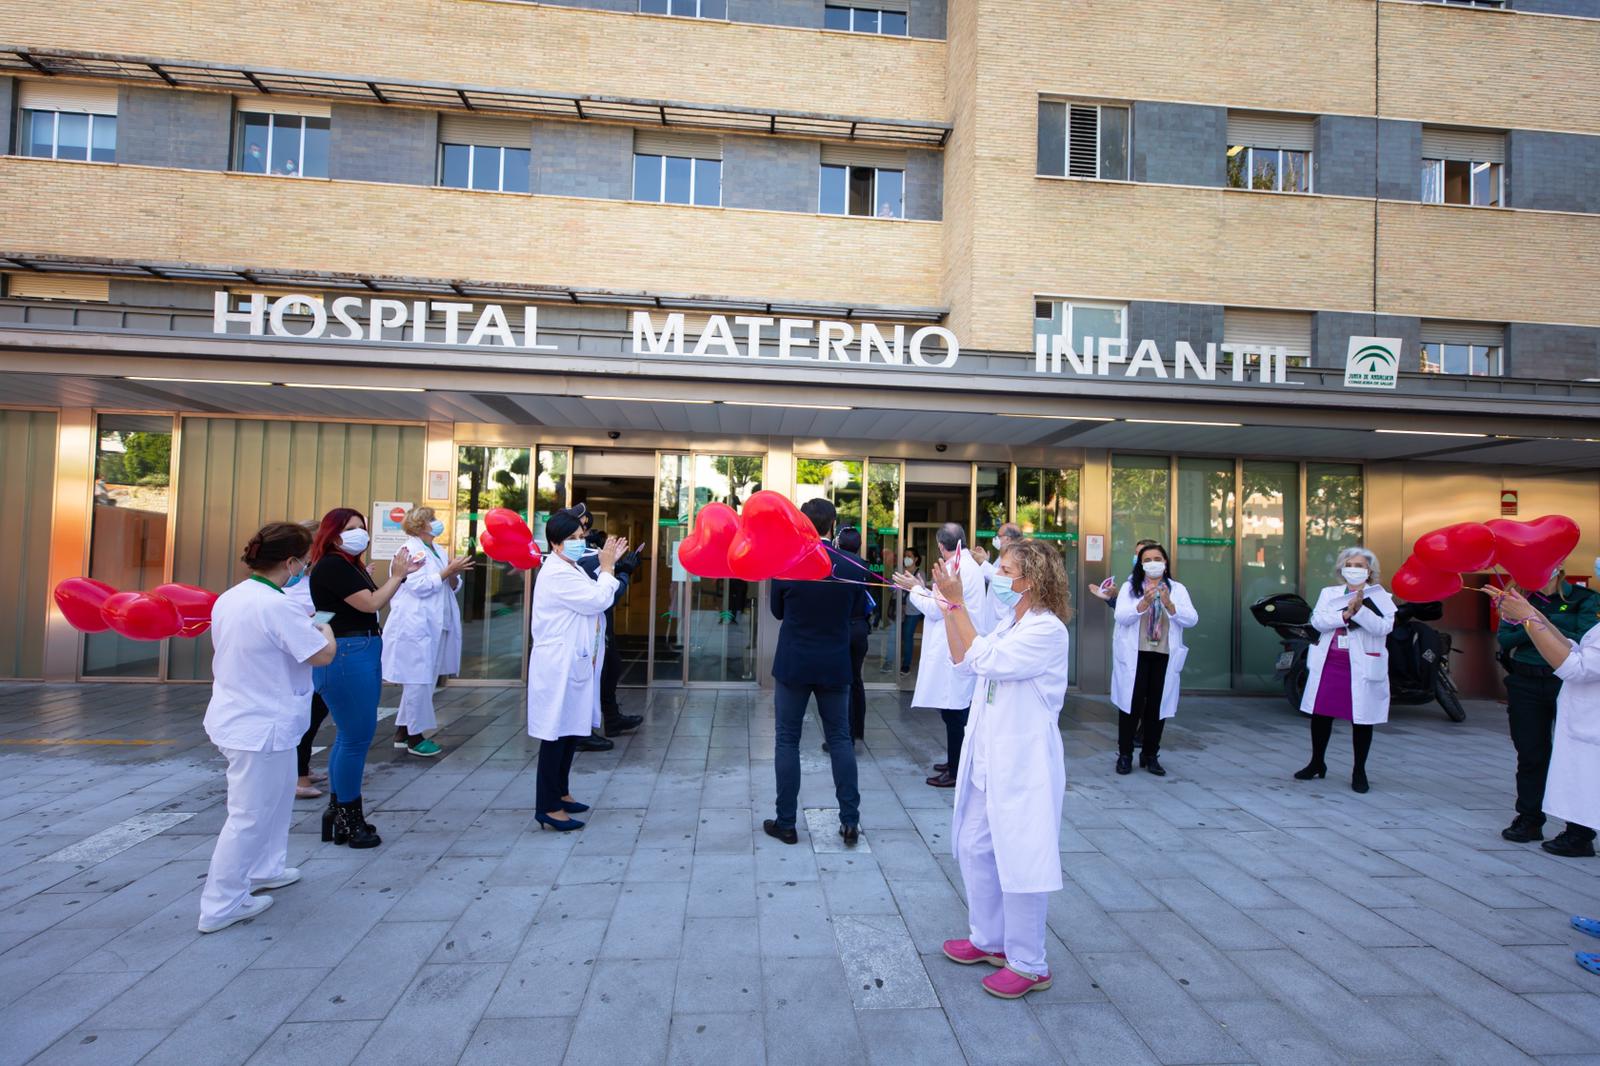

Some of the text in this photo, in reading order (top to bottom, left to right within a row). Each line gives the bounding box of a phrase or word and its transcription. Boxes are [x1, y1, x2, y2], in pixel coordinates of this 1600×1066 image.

[213, 291, 1304, 385] HOSPITAL MATERNO INFANTIL
